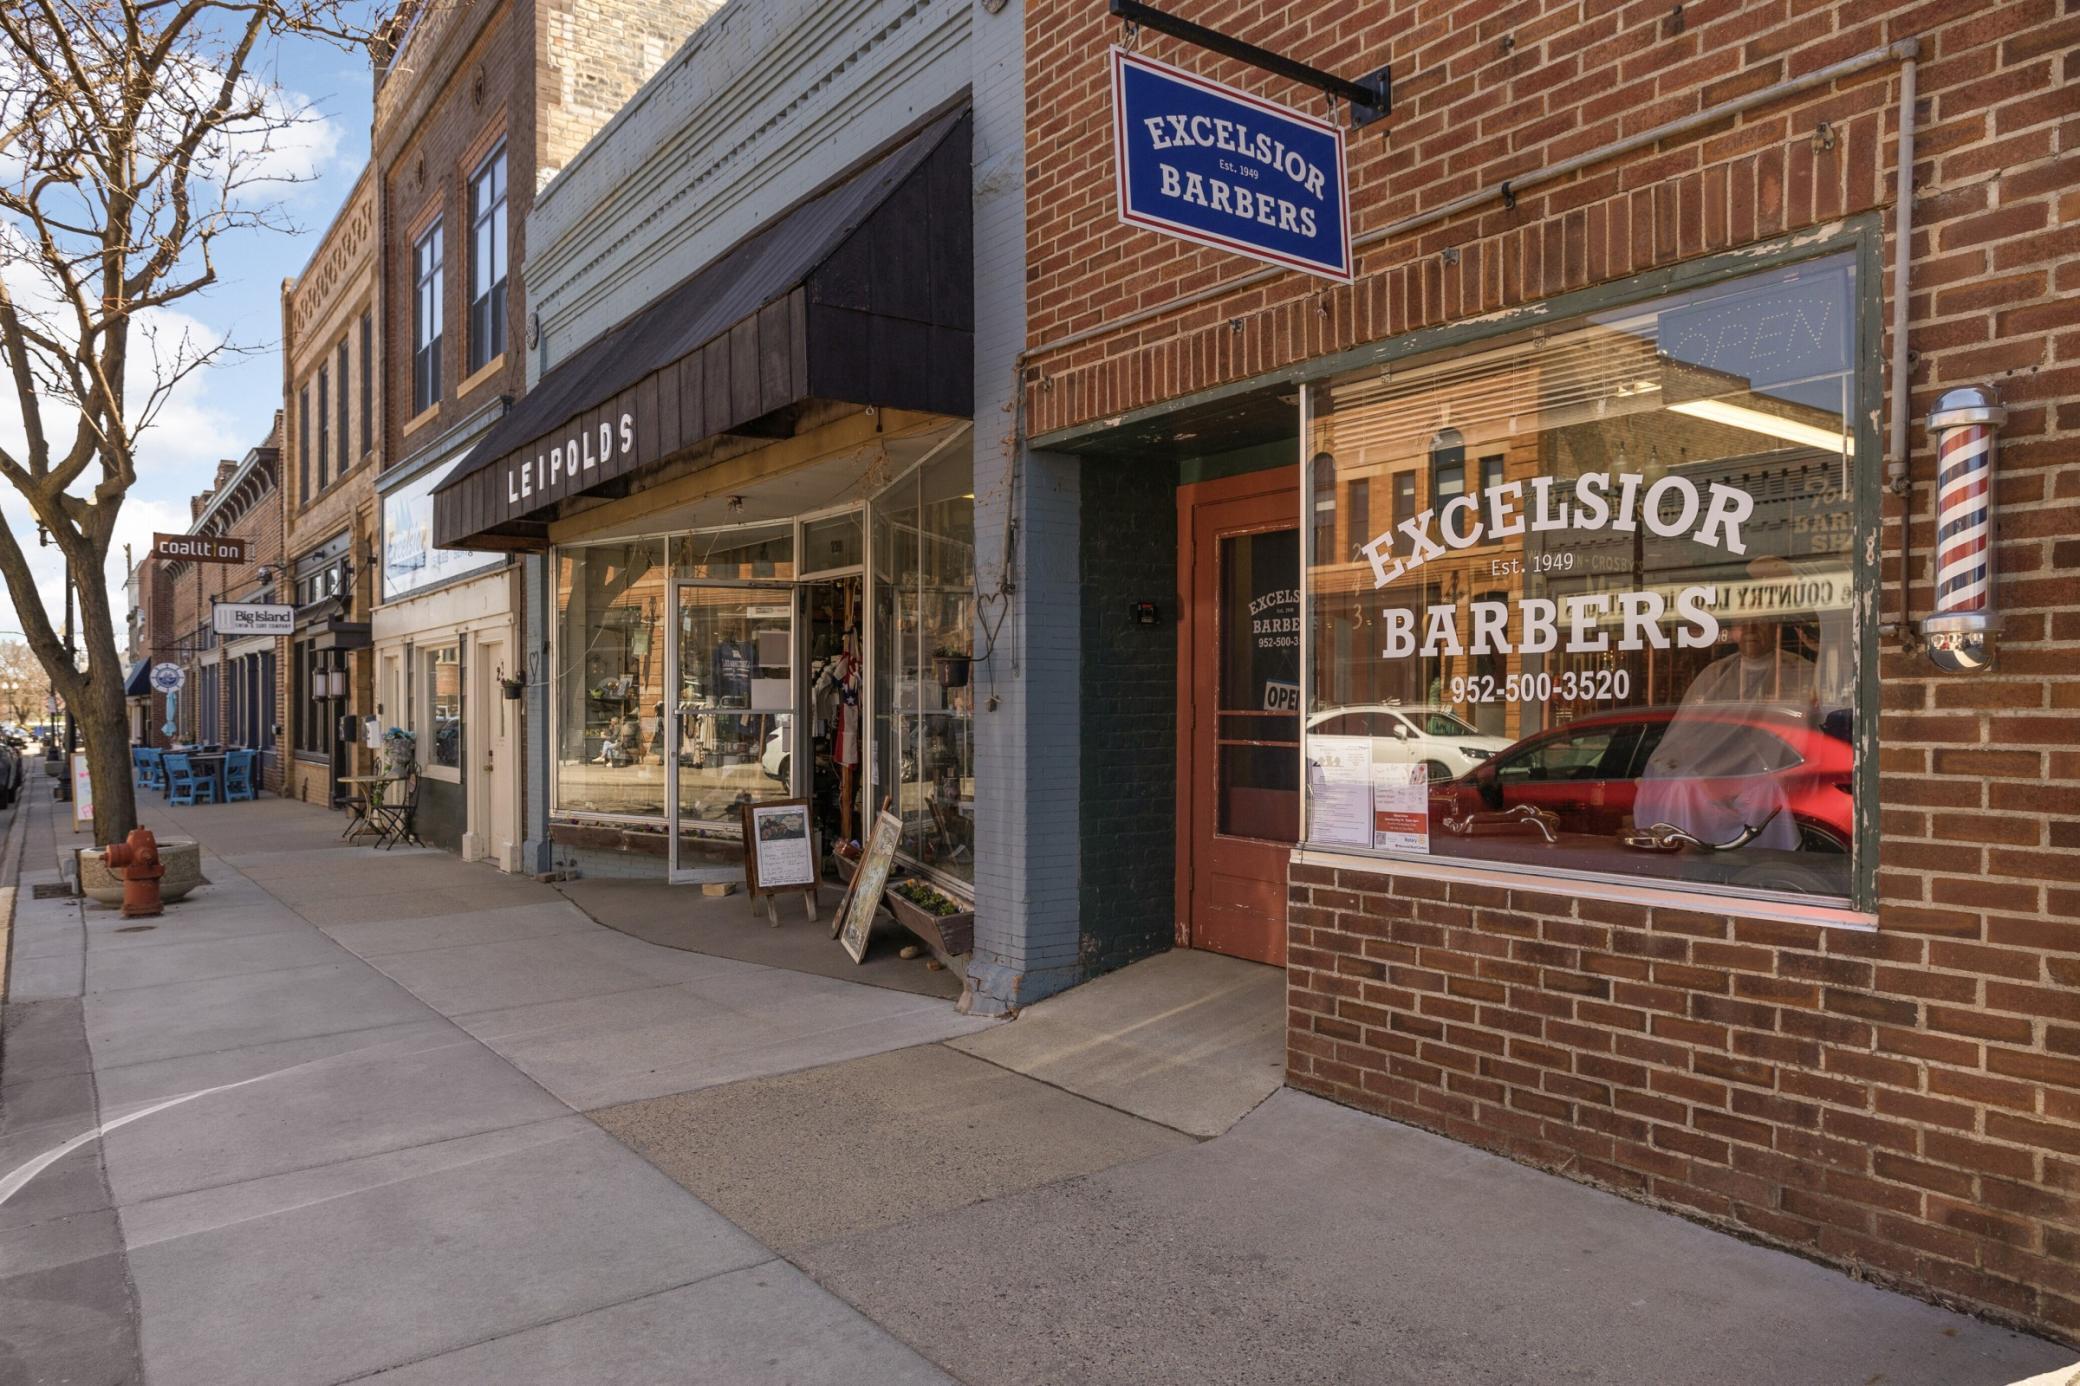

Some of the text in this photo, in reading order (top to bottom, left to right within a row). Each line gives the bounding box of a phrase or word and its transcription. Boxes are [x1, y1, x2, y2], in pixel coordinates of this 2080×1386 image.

[1144, 114, 1325, 200] EXCELSIOR
[1219, 158, 1259, 180] Est. 1949
[1160, 163, 1317, 238] BARBERS
[1673, 305, 1830, 373] OPEN
[508, 413, 634, 504] LEIPOLDS
[159, 541, 239, 558] coalition
[1361, 472, 1754, 590] EXCELSIOR
[1491, 552, 1574, 577] Est. 1949
[235, 611, 291, 624] Big Island
[1258, 636, 1300, 648] 952-500-3
[1382, 585, 1720, 659] BARBERS
[1450, 669, 1631, 704] 952-500-3520
